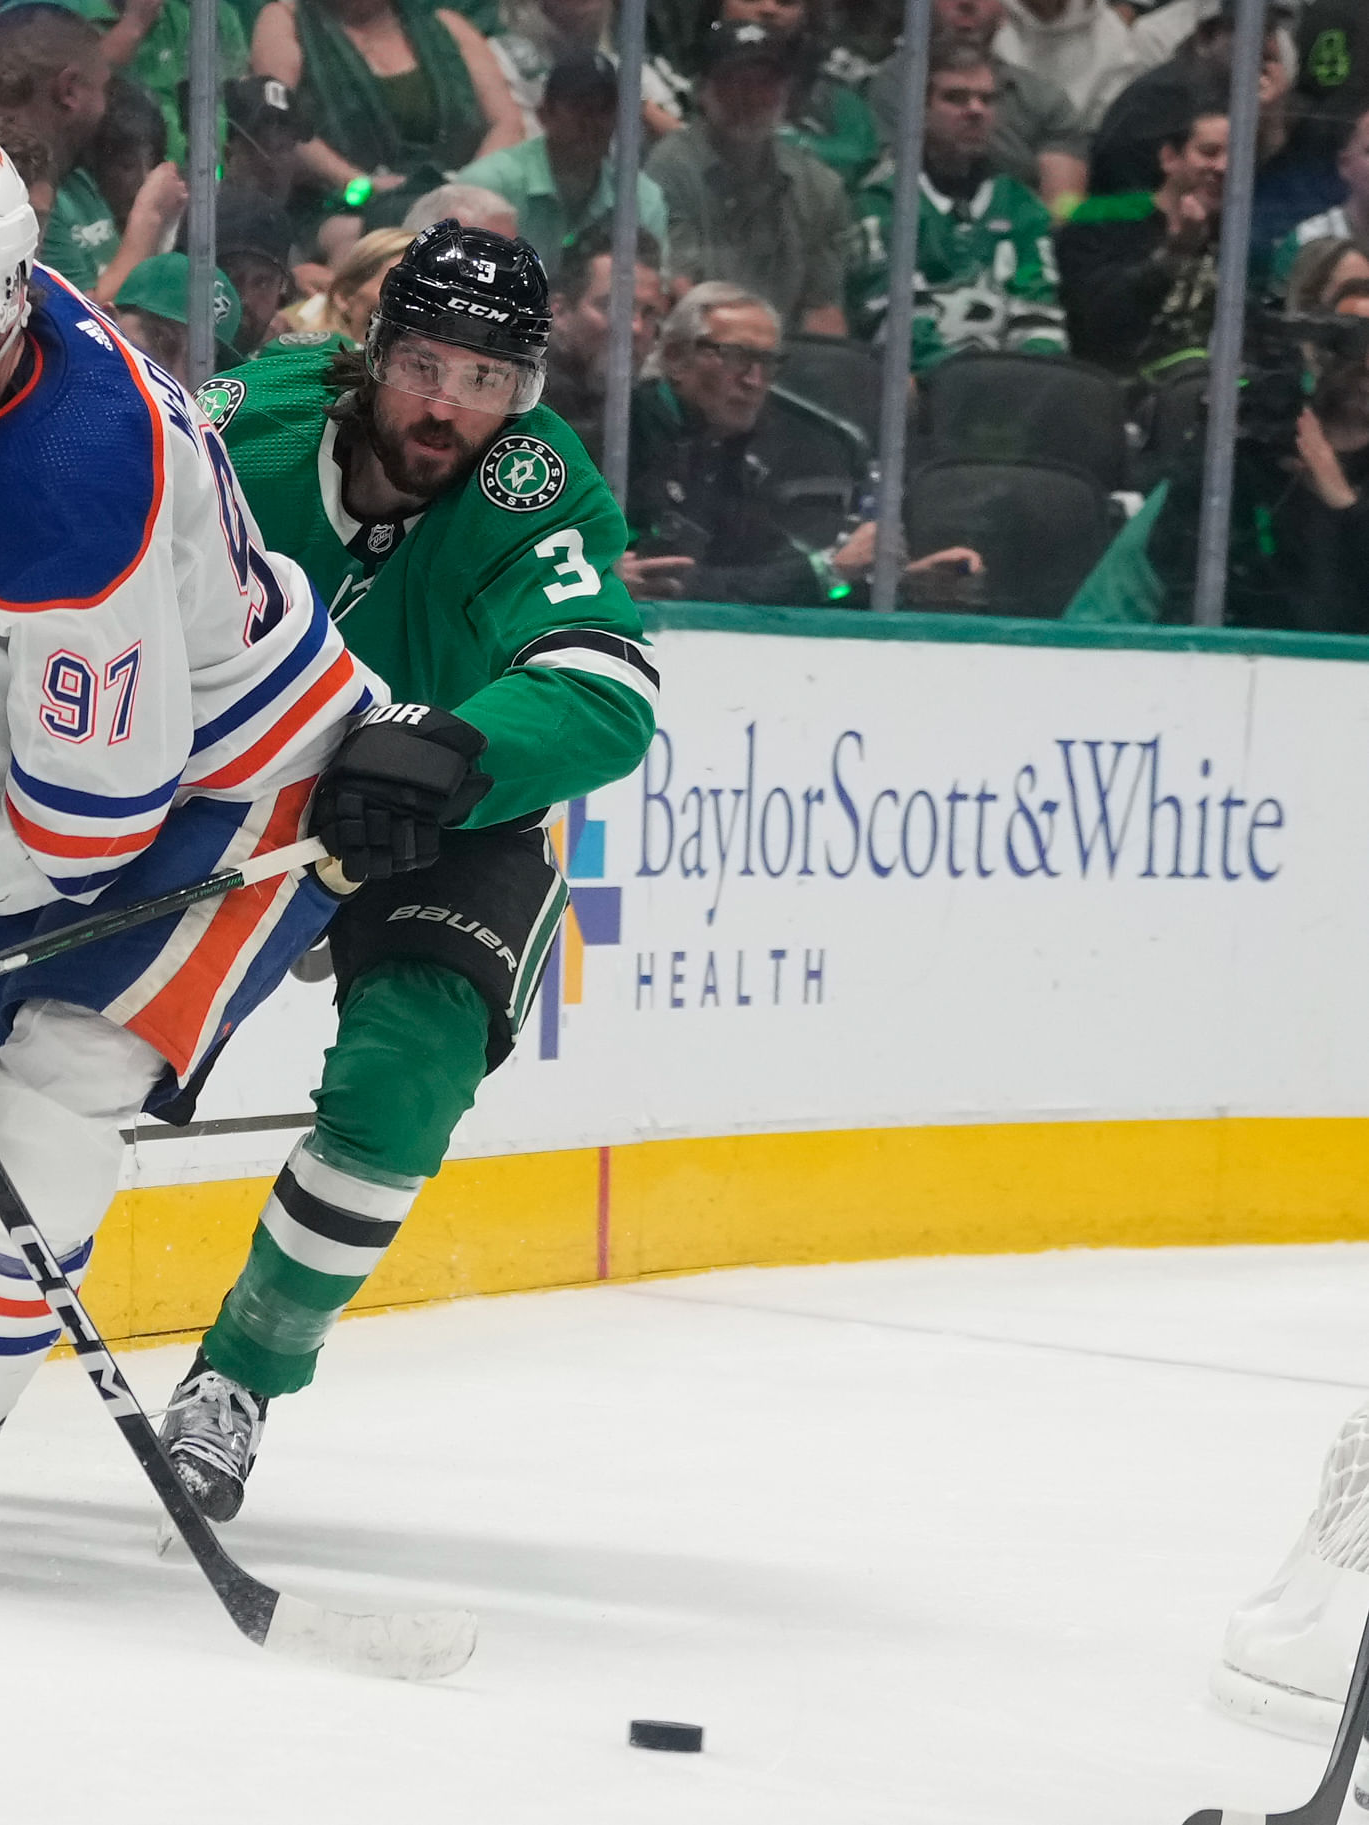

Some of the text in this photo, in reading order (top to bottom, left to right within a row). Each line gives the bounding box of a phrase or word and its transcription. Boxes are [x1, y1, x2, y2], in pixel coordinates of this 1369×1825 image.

[477, 259, 497, 284] 3
[447, 297, 510, 323] CCM
[486, 440, 545, 488] DALLAS
[506, 466, 561, 507] STARS
[533, 528, 602, 605] 3
[39, 639, 142, 745] 97
[636, 948, 825, 1011] HEALTH
[10, 1223, 143, 1419] CCM
